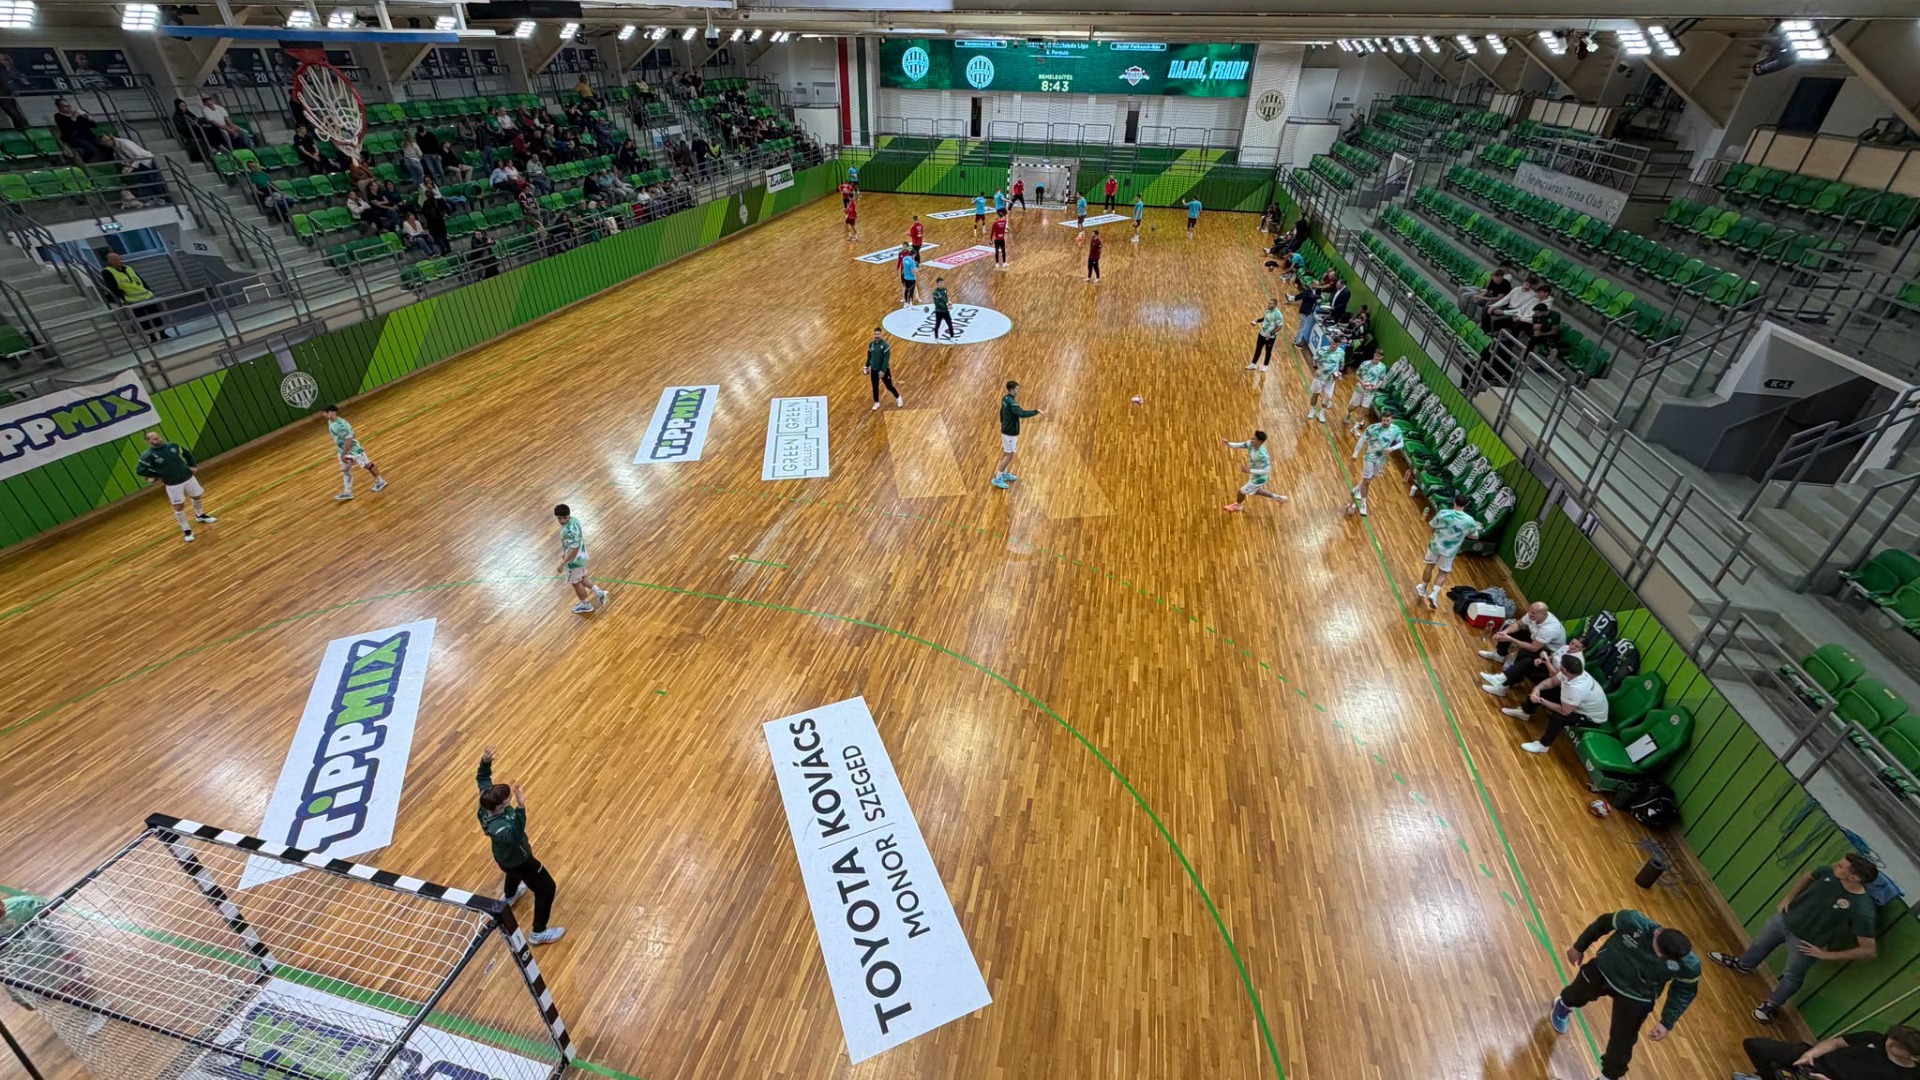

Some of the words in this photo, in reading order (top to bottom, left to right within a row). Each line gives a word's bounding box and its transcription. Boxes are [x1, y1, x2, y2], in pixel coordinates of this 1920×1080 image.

[1167, 56, 1208, 82] HAJRÁ,
[1208, 60, 1249, 80] FRADI!
[1041, 81, 1070, 92] 8:43
[1585, 193, 1603, 209] Club
[785, 401, 800, 429] GREEN
[804, 404, 813, 425] COLLECT
[782, 438, 799, 472] GREEN
[803, 441, 812, 467] COLLECT
[1593, 614, 1609, 633] 12
[789, 718, 850, 838] KOVÁCS
[842, 745, 886, 822] SZEGED
[875, 833, 931, 939] MONOR
[832, 846, 912, 1035] TOYOTA
